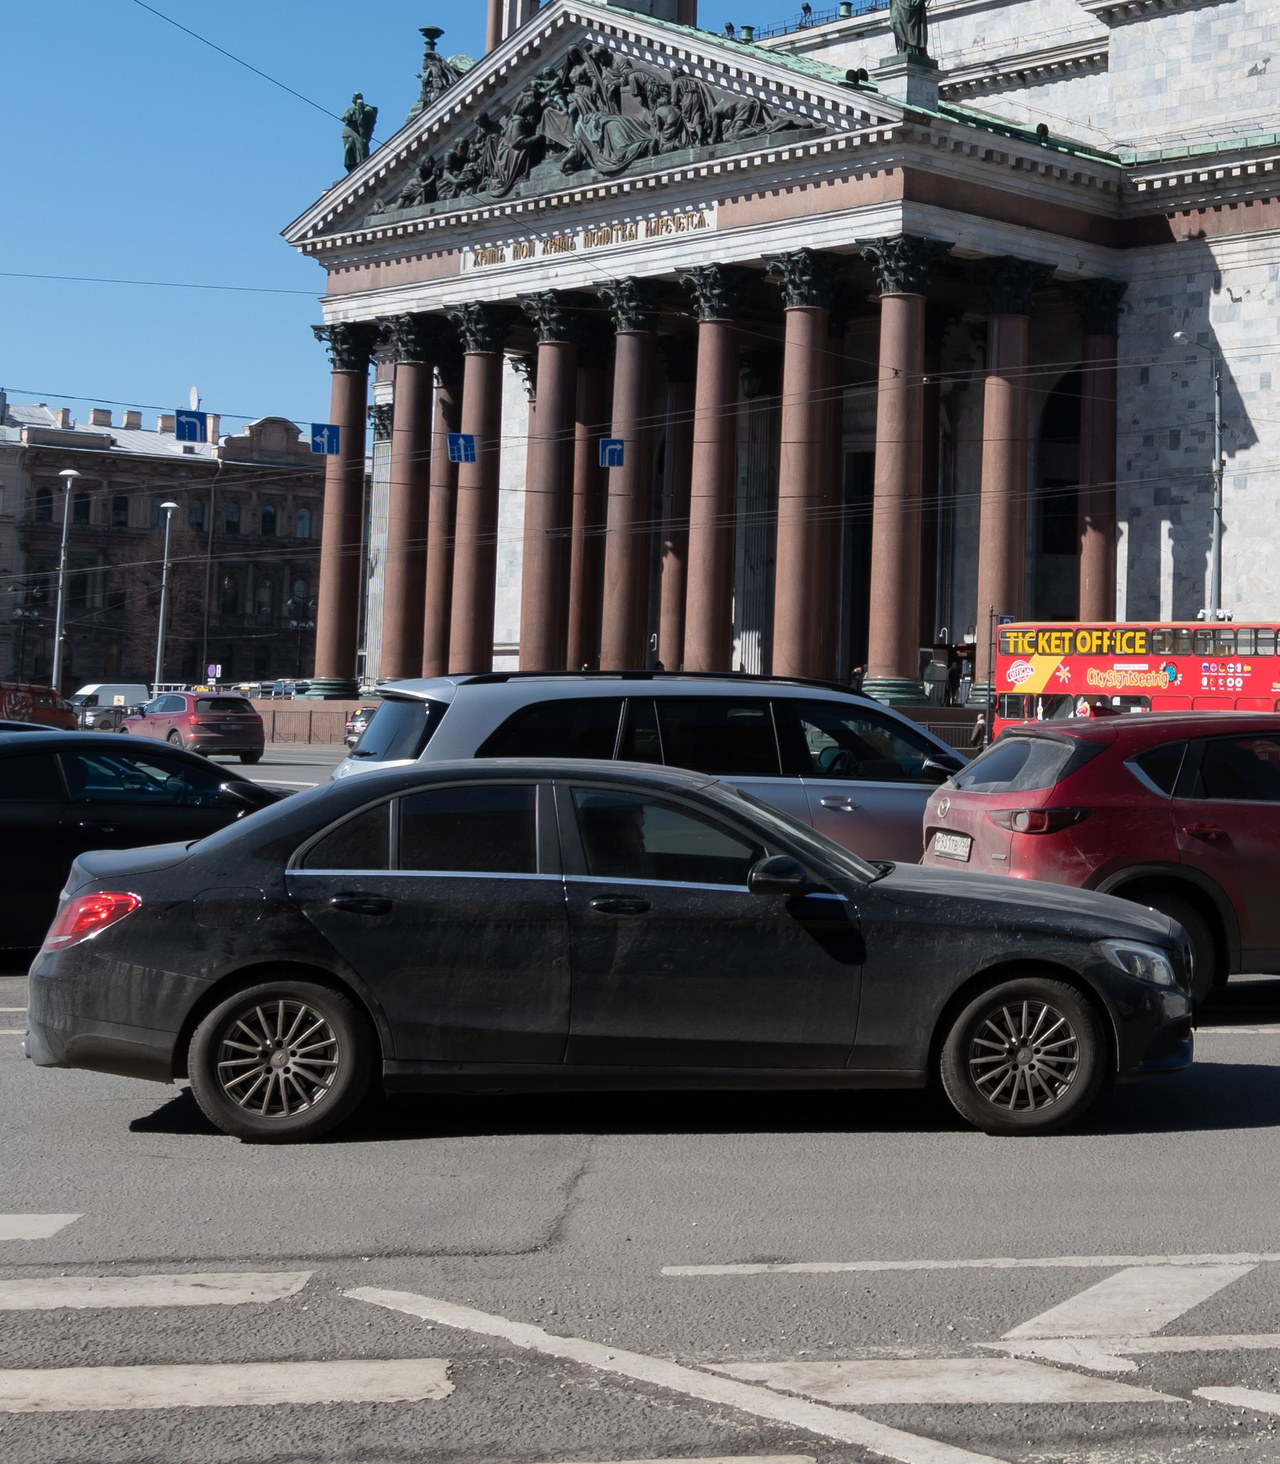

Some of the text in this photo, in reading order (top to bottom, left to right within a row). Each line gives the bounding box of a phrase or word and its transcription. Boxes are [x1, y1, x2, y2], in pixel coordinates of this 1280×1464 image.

[1005, 631, 1074, 654] TICKET
[1076, 630, 1147, 654] OFFICE
[1086, 667, 1170, 690] CitySightseeing
